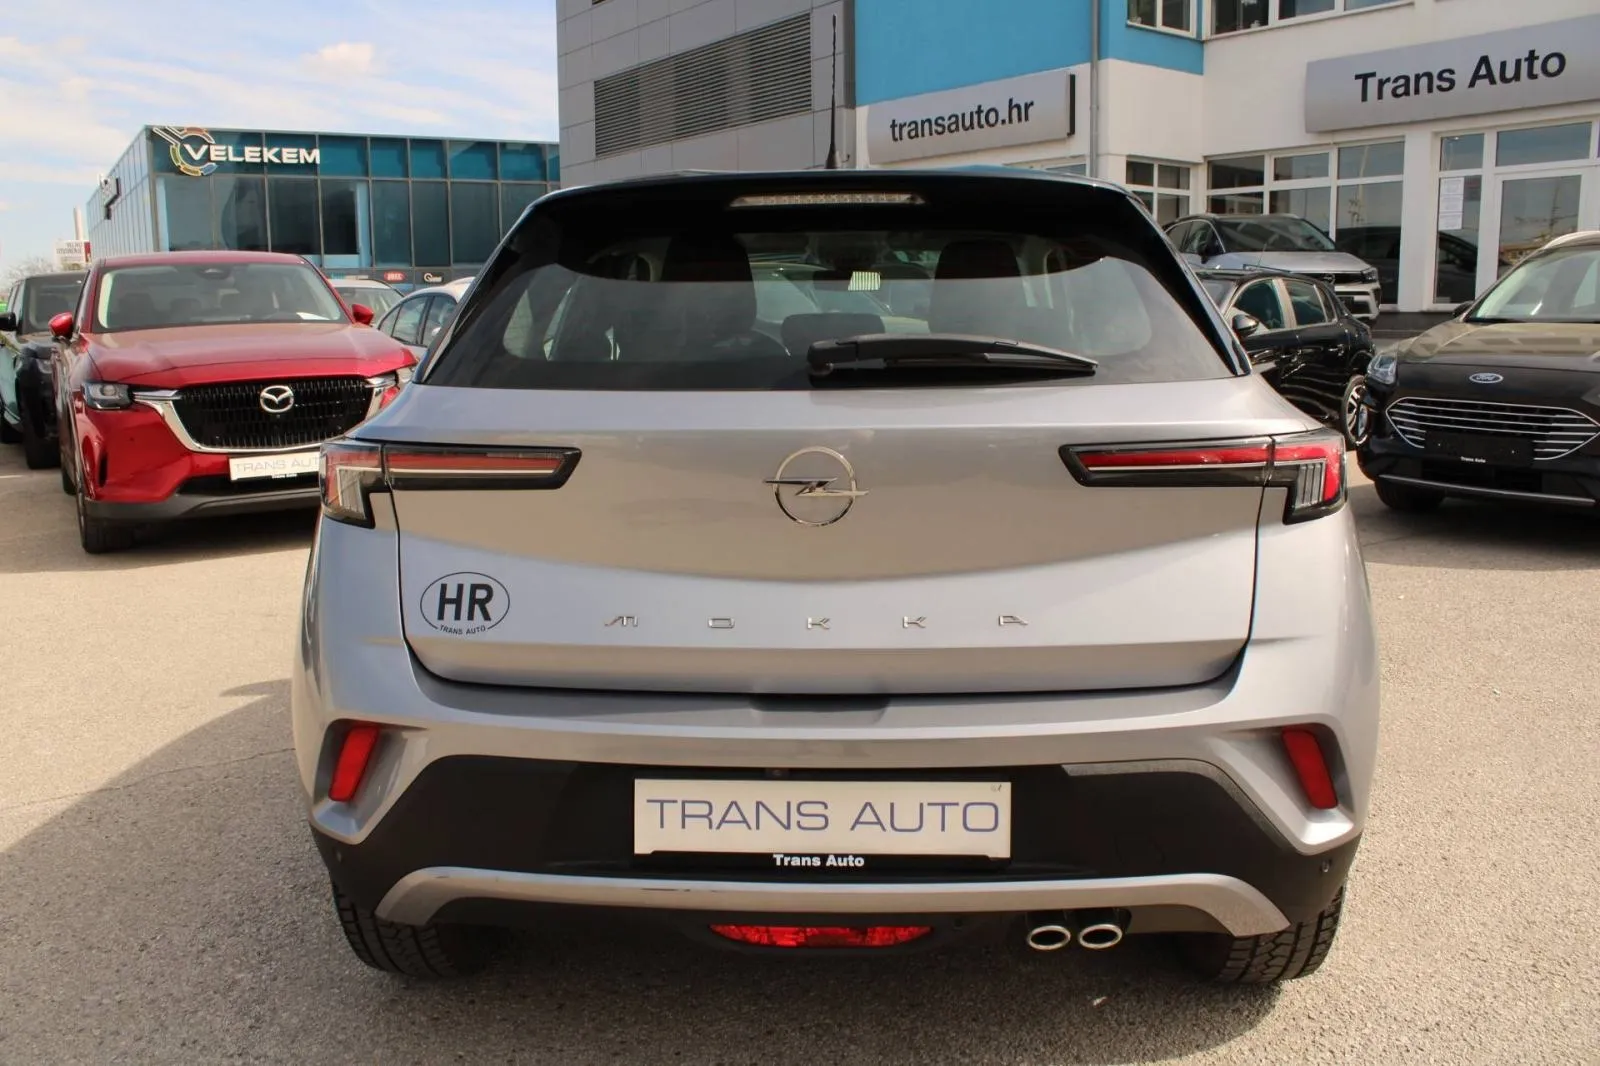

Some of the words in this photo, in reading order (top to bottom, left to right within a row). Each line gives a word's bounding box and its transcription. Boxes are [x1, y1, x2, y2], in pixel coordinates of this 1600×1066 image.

[1355, 71, 1456, 103] Trans
[1467, 49, 1566, 89] Auto
[890, 97, 1034, 142] transauto.hr
[184, 144, 321, 165] VELEKEM
[234, 459, 286, 472] TRANS
[291, 456, 320, 469] AUT
[437, 583, 494, 622] HR
[439, 624, 463, 635] TRANS
[465, 625, 486, 635] AUTO
[604, 614, 1029, 630] MOKKA
[646, 798, 830, 832] TRANS
[849, 801, 1000, 833] AUTO
[773, 853, 821, 866] Trans
[825, 854, 865, 867] Auto
